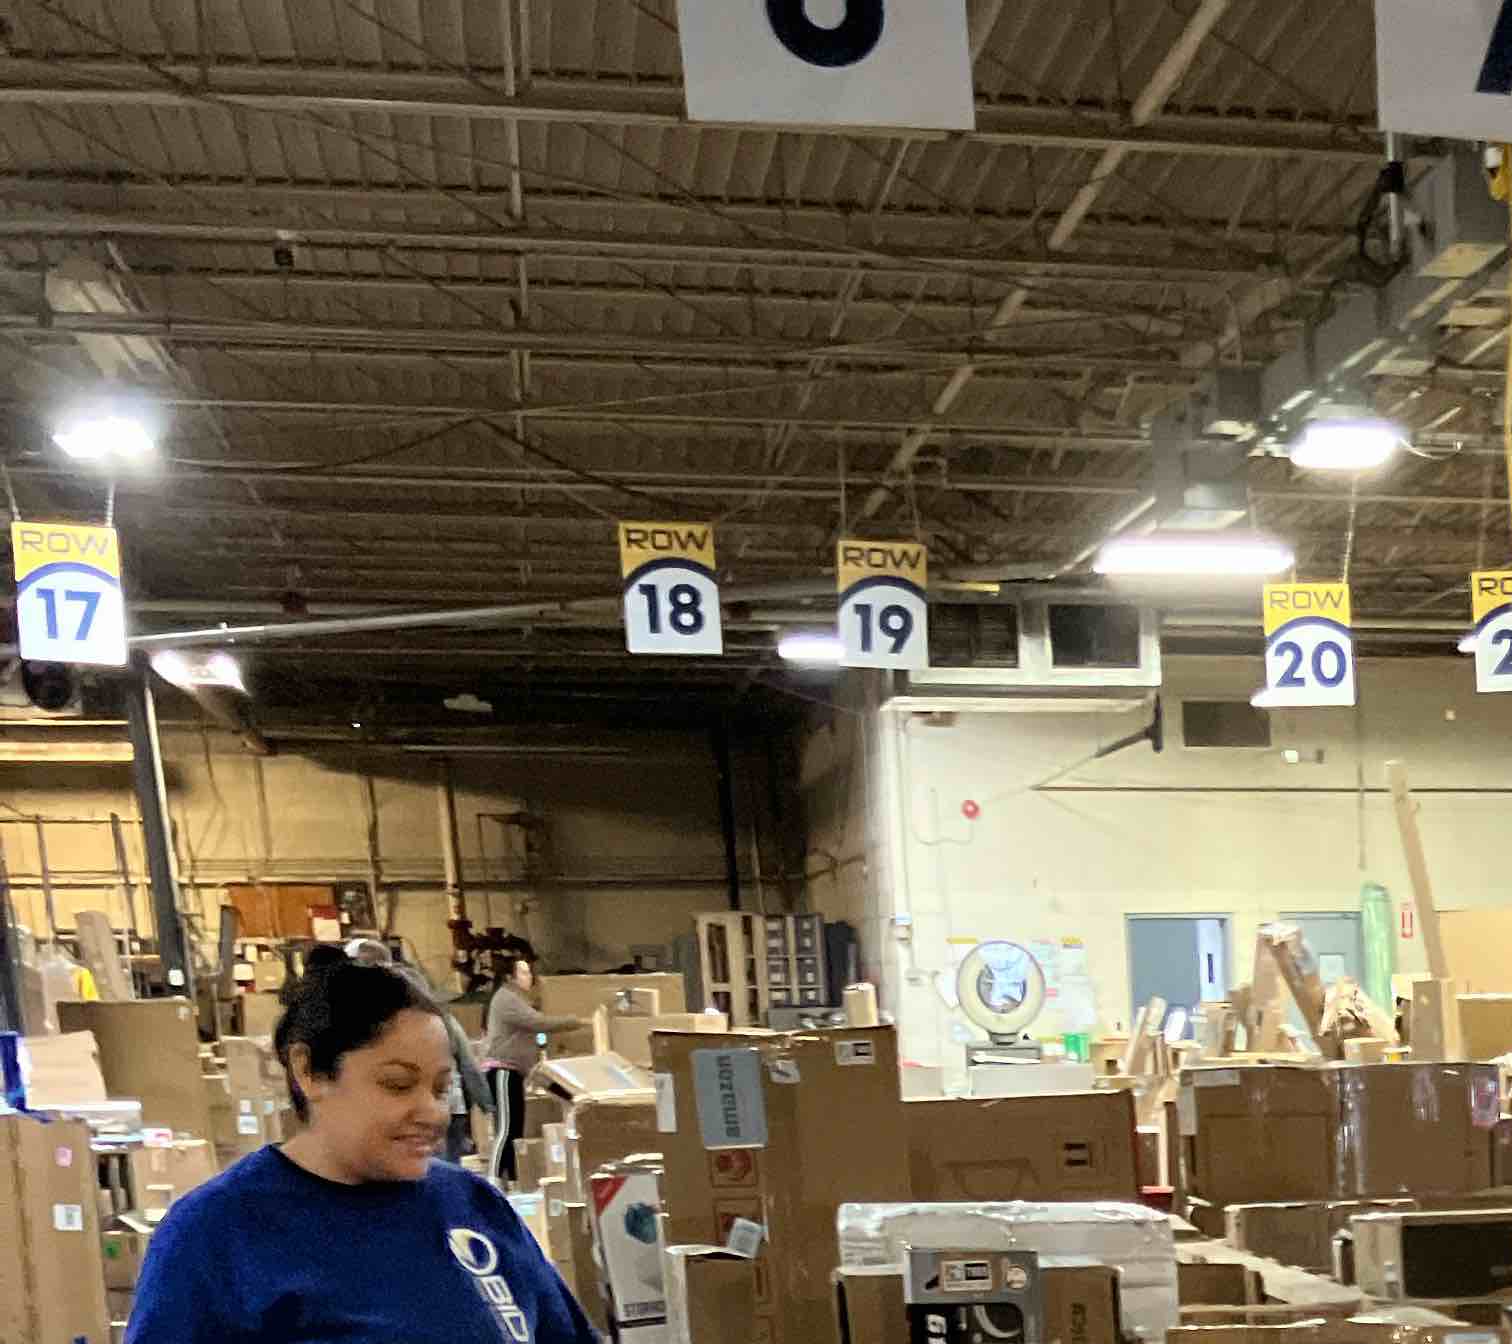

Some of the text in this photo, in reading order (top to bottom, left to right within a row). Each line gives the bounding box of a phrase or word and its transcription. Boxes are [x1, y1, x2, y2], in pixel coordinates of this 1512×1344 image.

[20, 529, 109, 556] ROW
[625, 528, 713, 551] ROW
[842, 548, 922, 569] ROW
[36, 588, 101, 640] 17
[638, 583, 704, 635] 18
[1269, 589, 1345, 610] ROW
[852, 604, 914, 653] 19
[1274, 641, 1347, 687] 20
[716, 1055, 741, 1137] amazon
